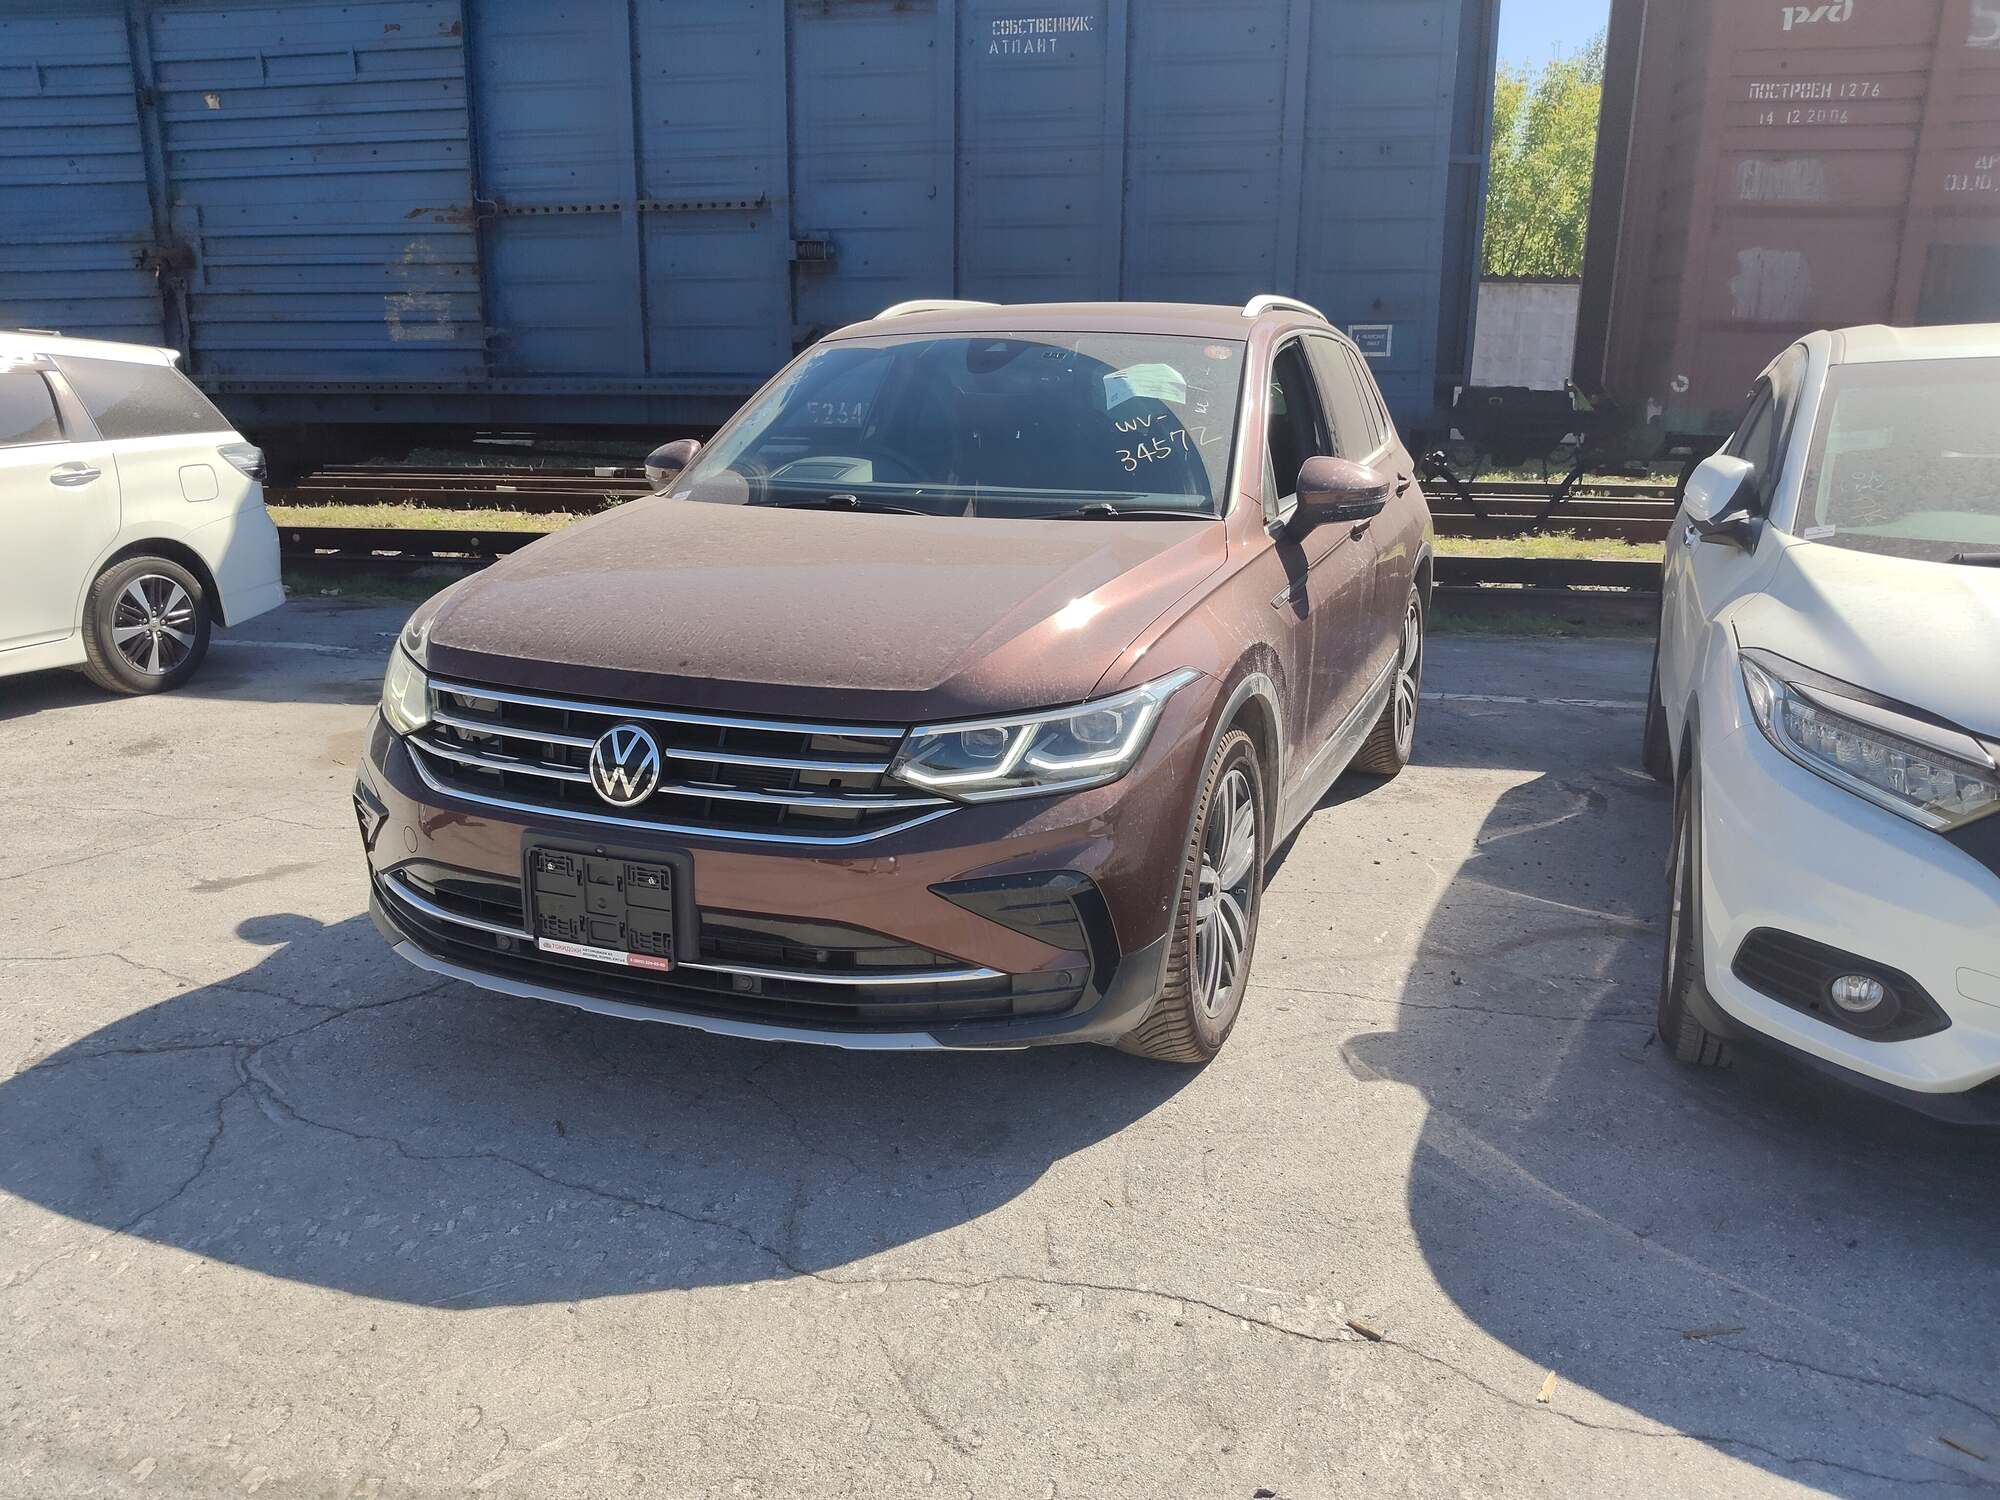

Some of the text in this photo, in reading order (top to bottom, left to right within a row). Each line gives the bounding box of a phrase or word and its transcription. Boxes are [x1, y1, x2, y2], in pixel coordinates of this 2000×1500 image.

[1749, 82, 1880, 99] ПОСТРОЕН 1276
[1786, 109, 1801, 124] 12
